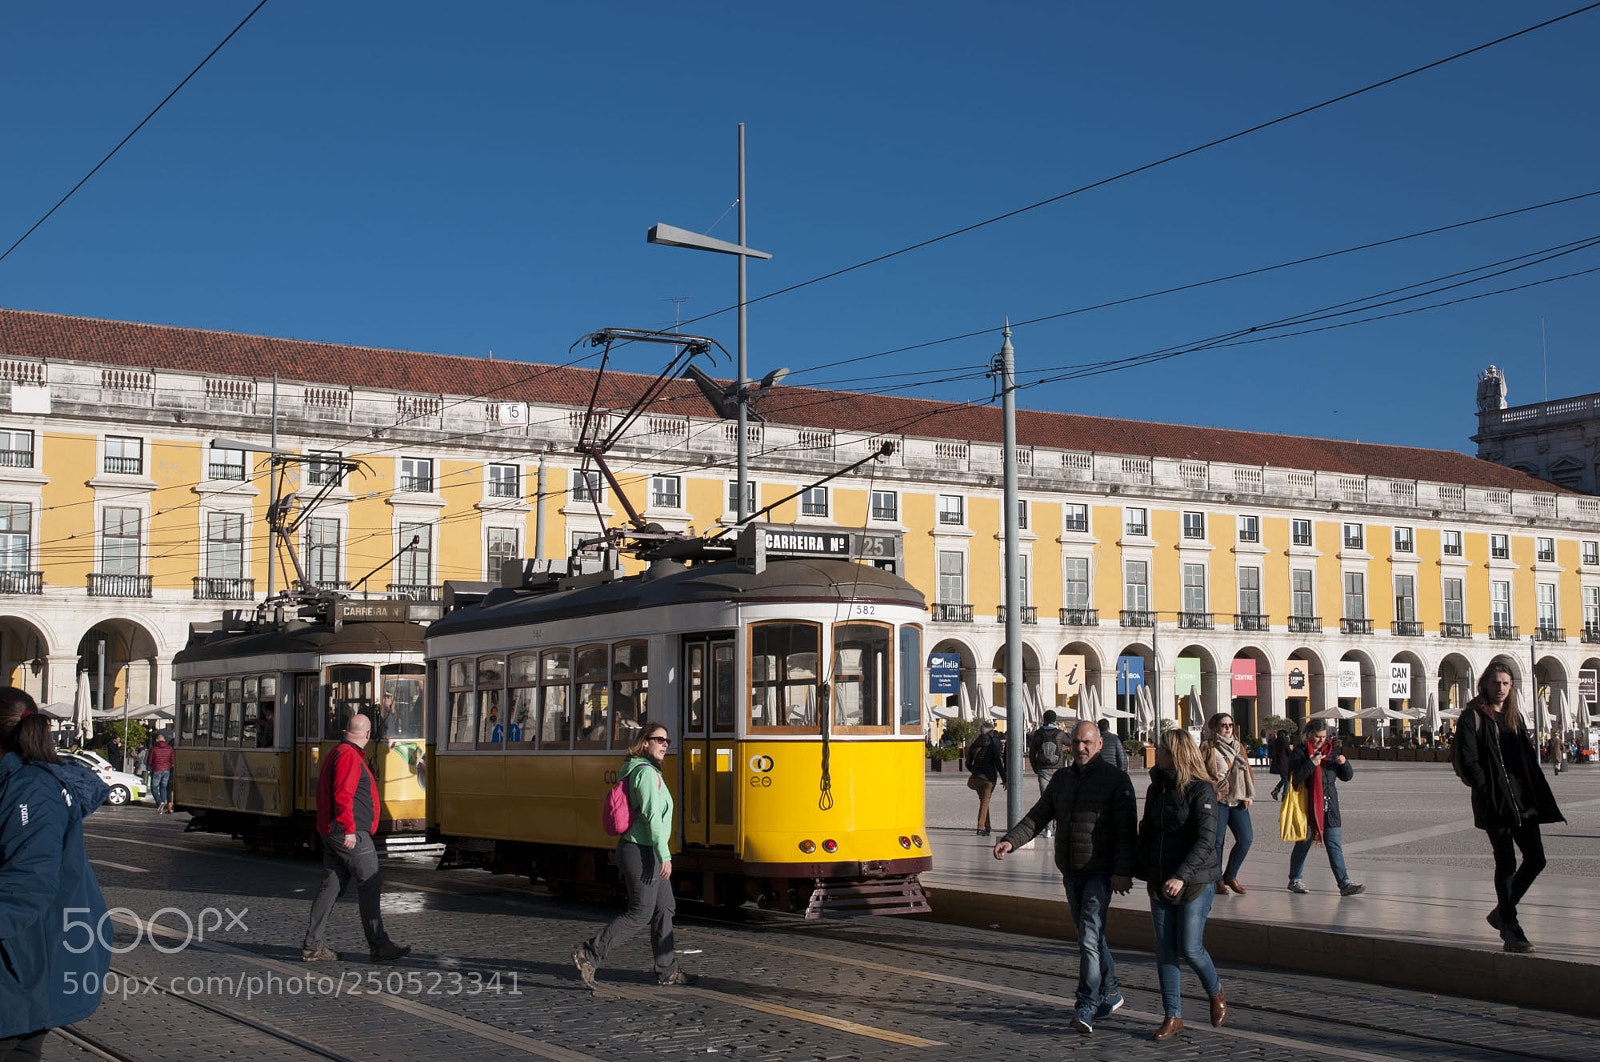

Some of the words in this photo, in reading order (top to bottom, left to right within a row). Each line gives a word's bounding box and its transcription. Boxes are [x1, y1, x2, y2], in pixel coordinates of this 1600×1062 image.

[507, 405, 519, 418] 15
[765, 534, 824, 551] CARREIRA
[863, 537, 884, 556] 25
[343, 607, 388, 616] CARREIRA
[856, 605, 875, 615] 582
[942, 660, 959, 668] Italia
[1392, 667, 1407, 679] CAN
[1392, 683, 1407, 694] CAN
